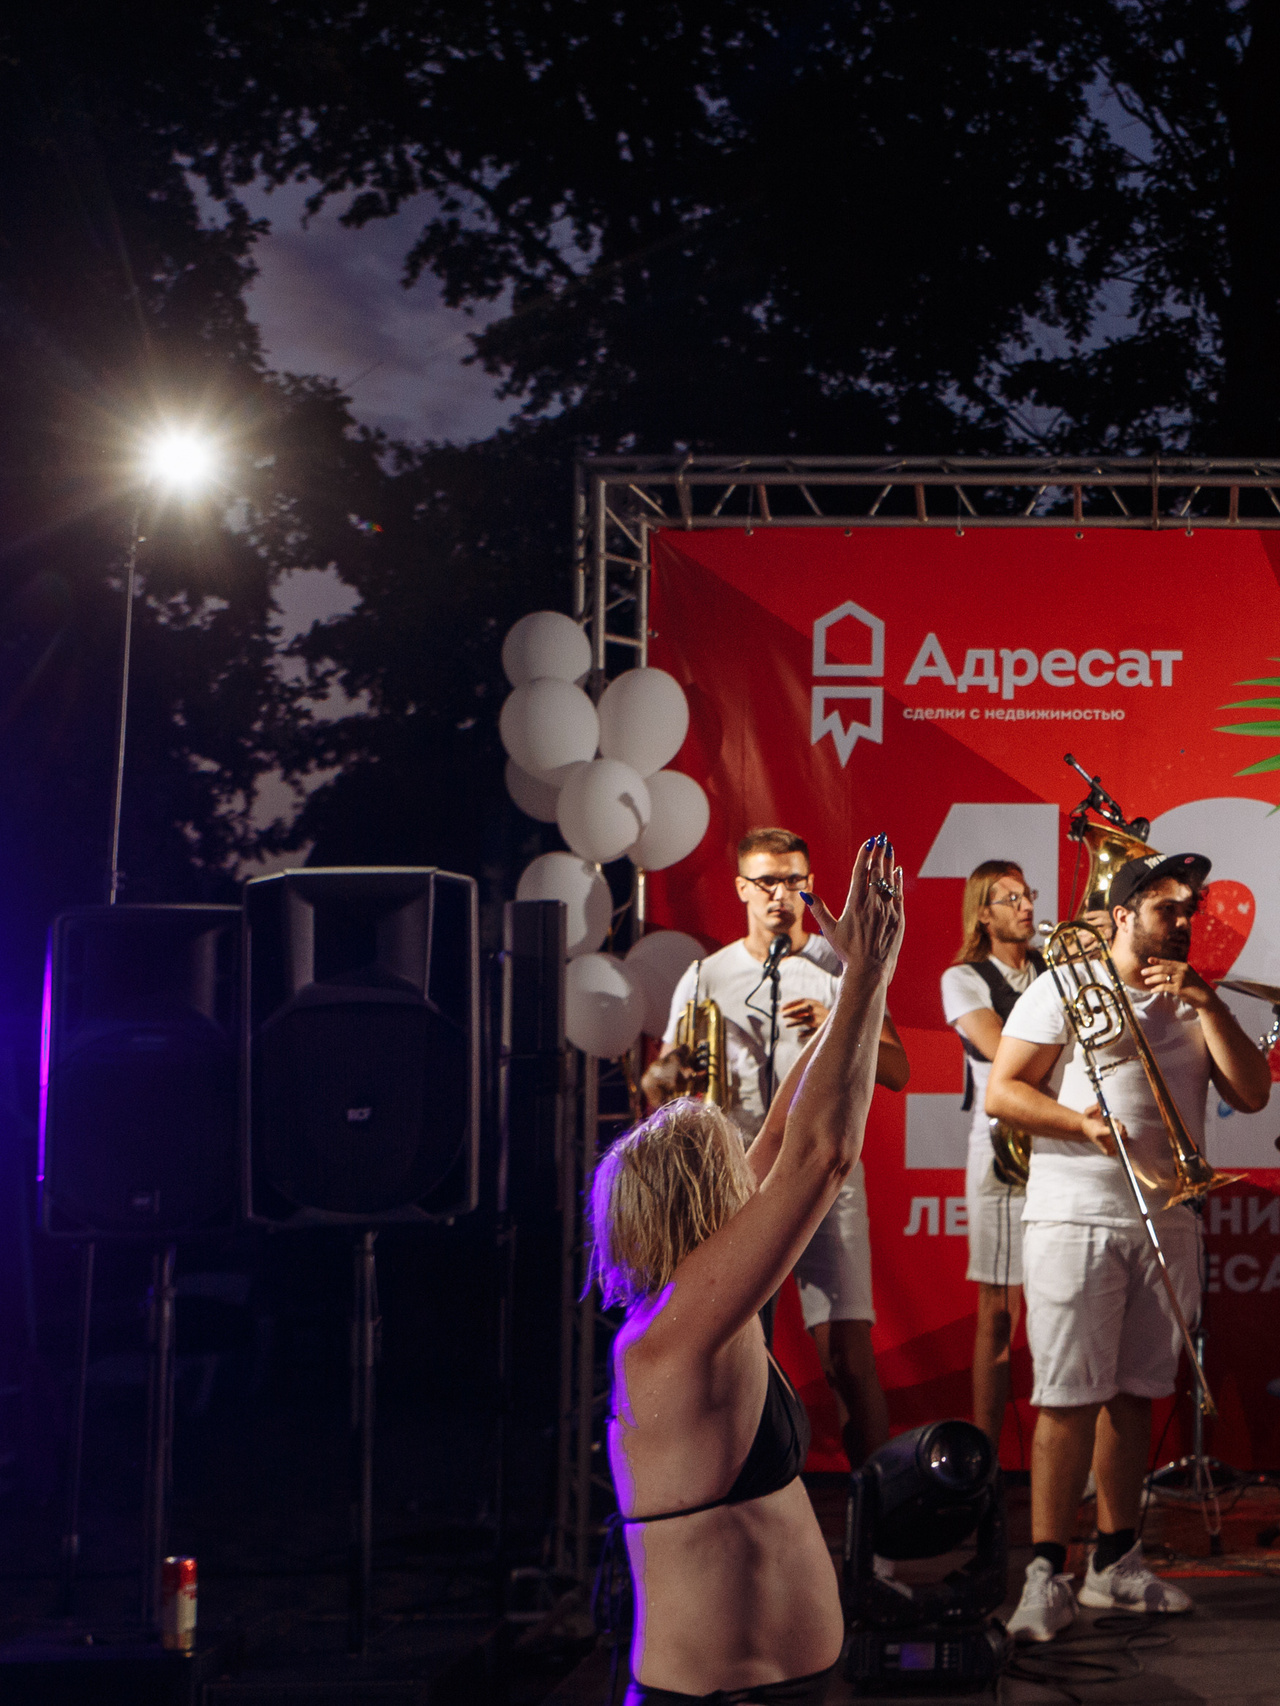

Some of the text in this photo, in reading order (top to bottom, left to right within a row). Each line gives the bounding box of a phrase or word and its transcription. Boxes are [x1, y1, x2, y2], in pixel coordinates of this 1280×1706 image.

[903, 631, 1184, 700] Адресат
[902, 707, 1126, 722] сделки с недвижимостью
[902, 1196, 969, 1236] ЛЕ
